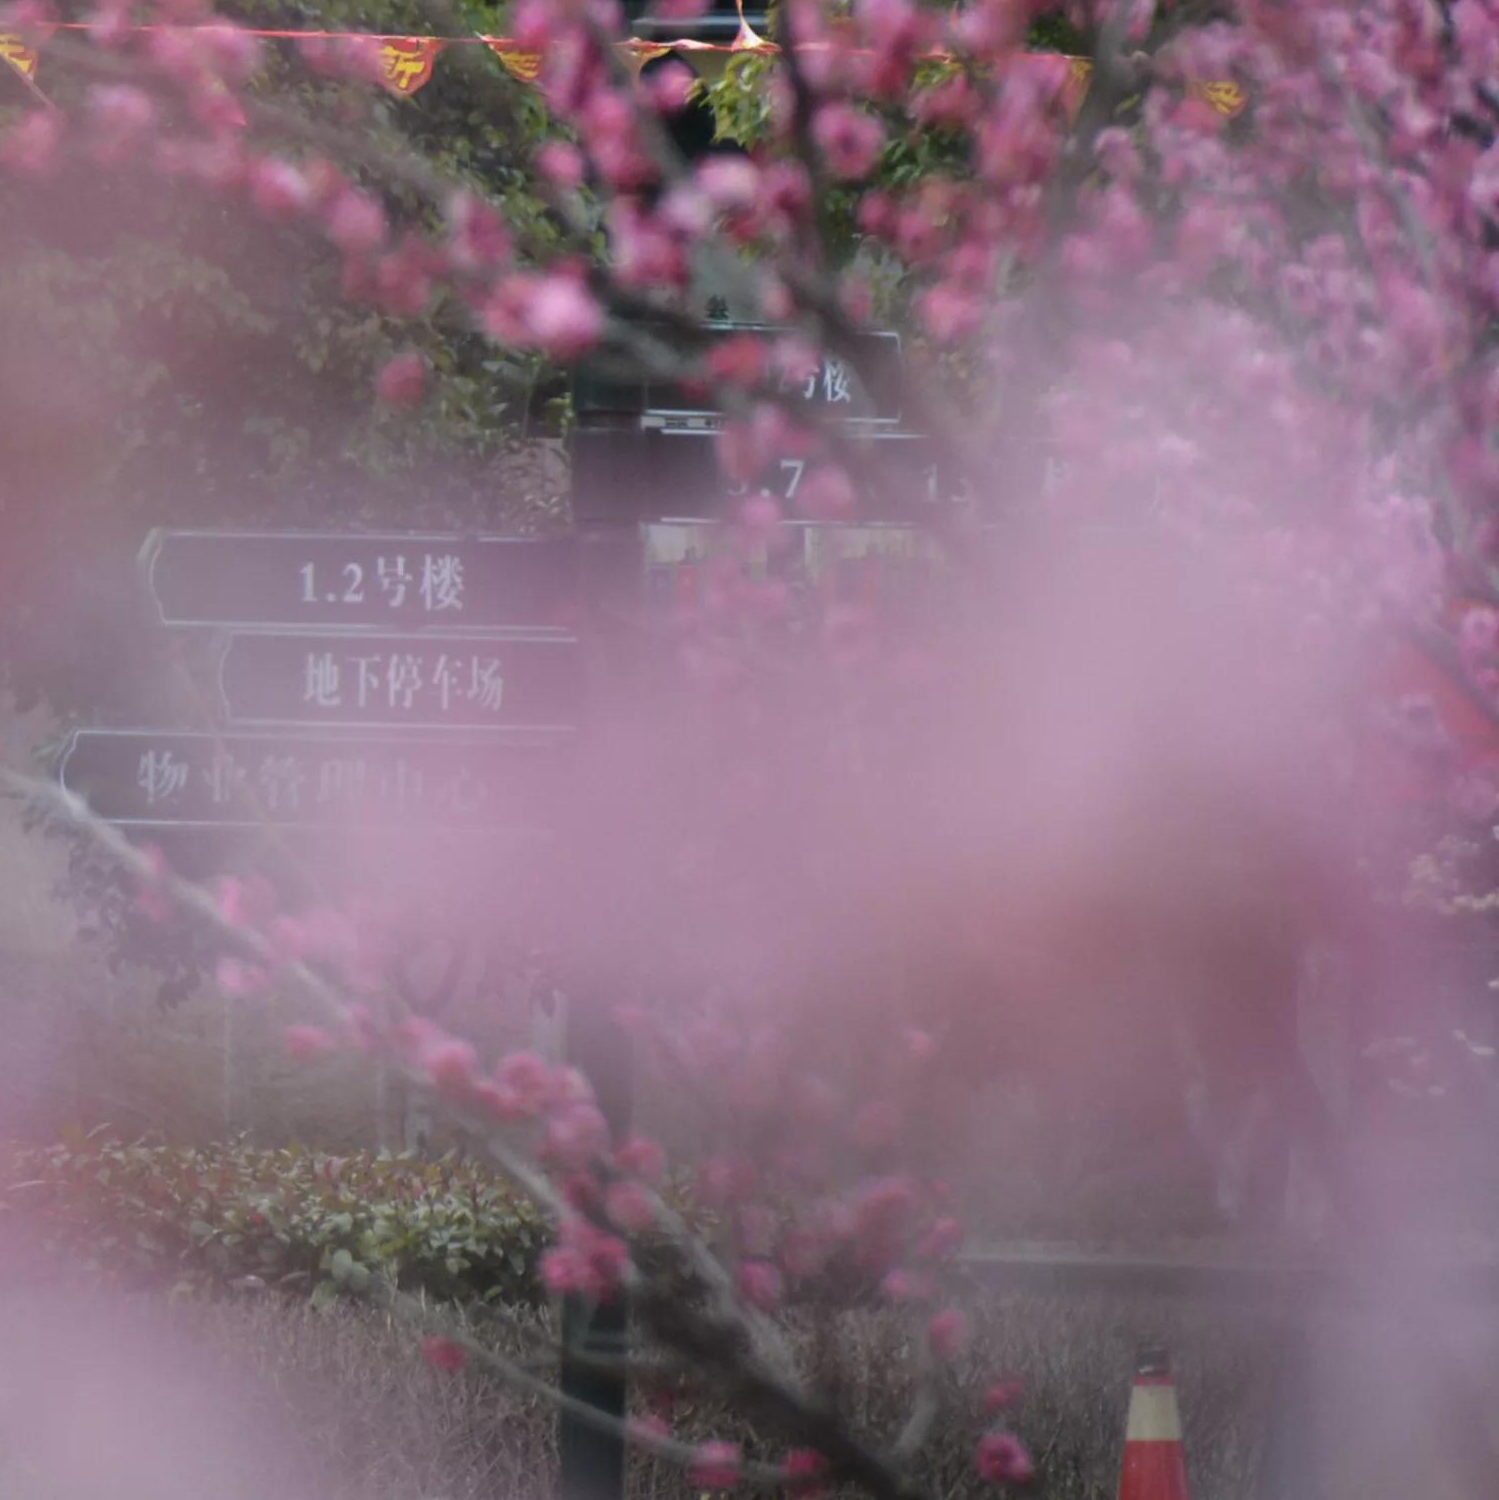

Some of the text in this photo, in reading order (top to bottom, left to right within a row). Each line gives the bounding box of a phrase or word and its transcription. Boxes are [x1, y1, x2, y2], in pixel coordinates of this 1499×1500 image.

[299, 553, 465, 612] 1.2号楼
[303, 652, 505, 712] 地下停车场
